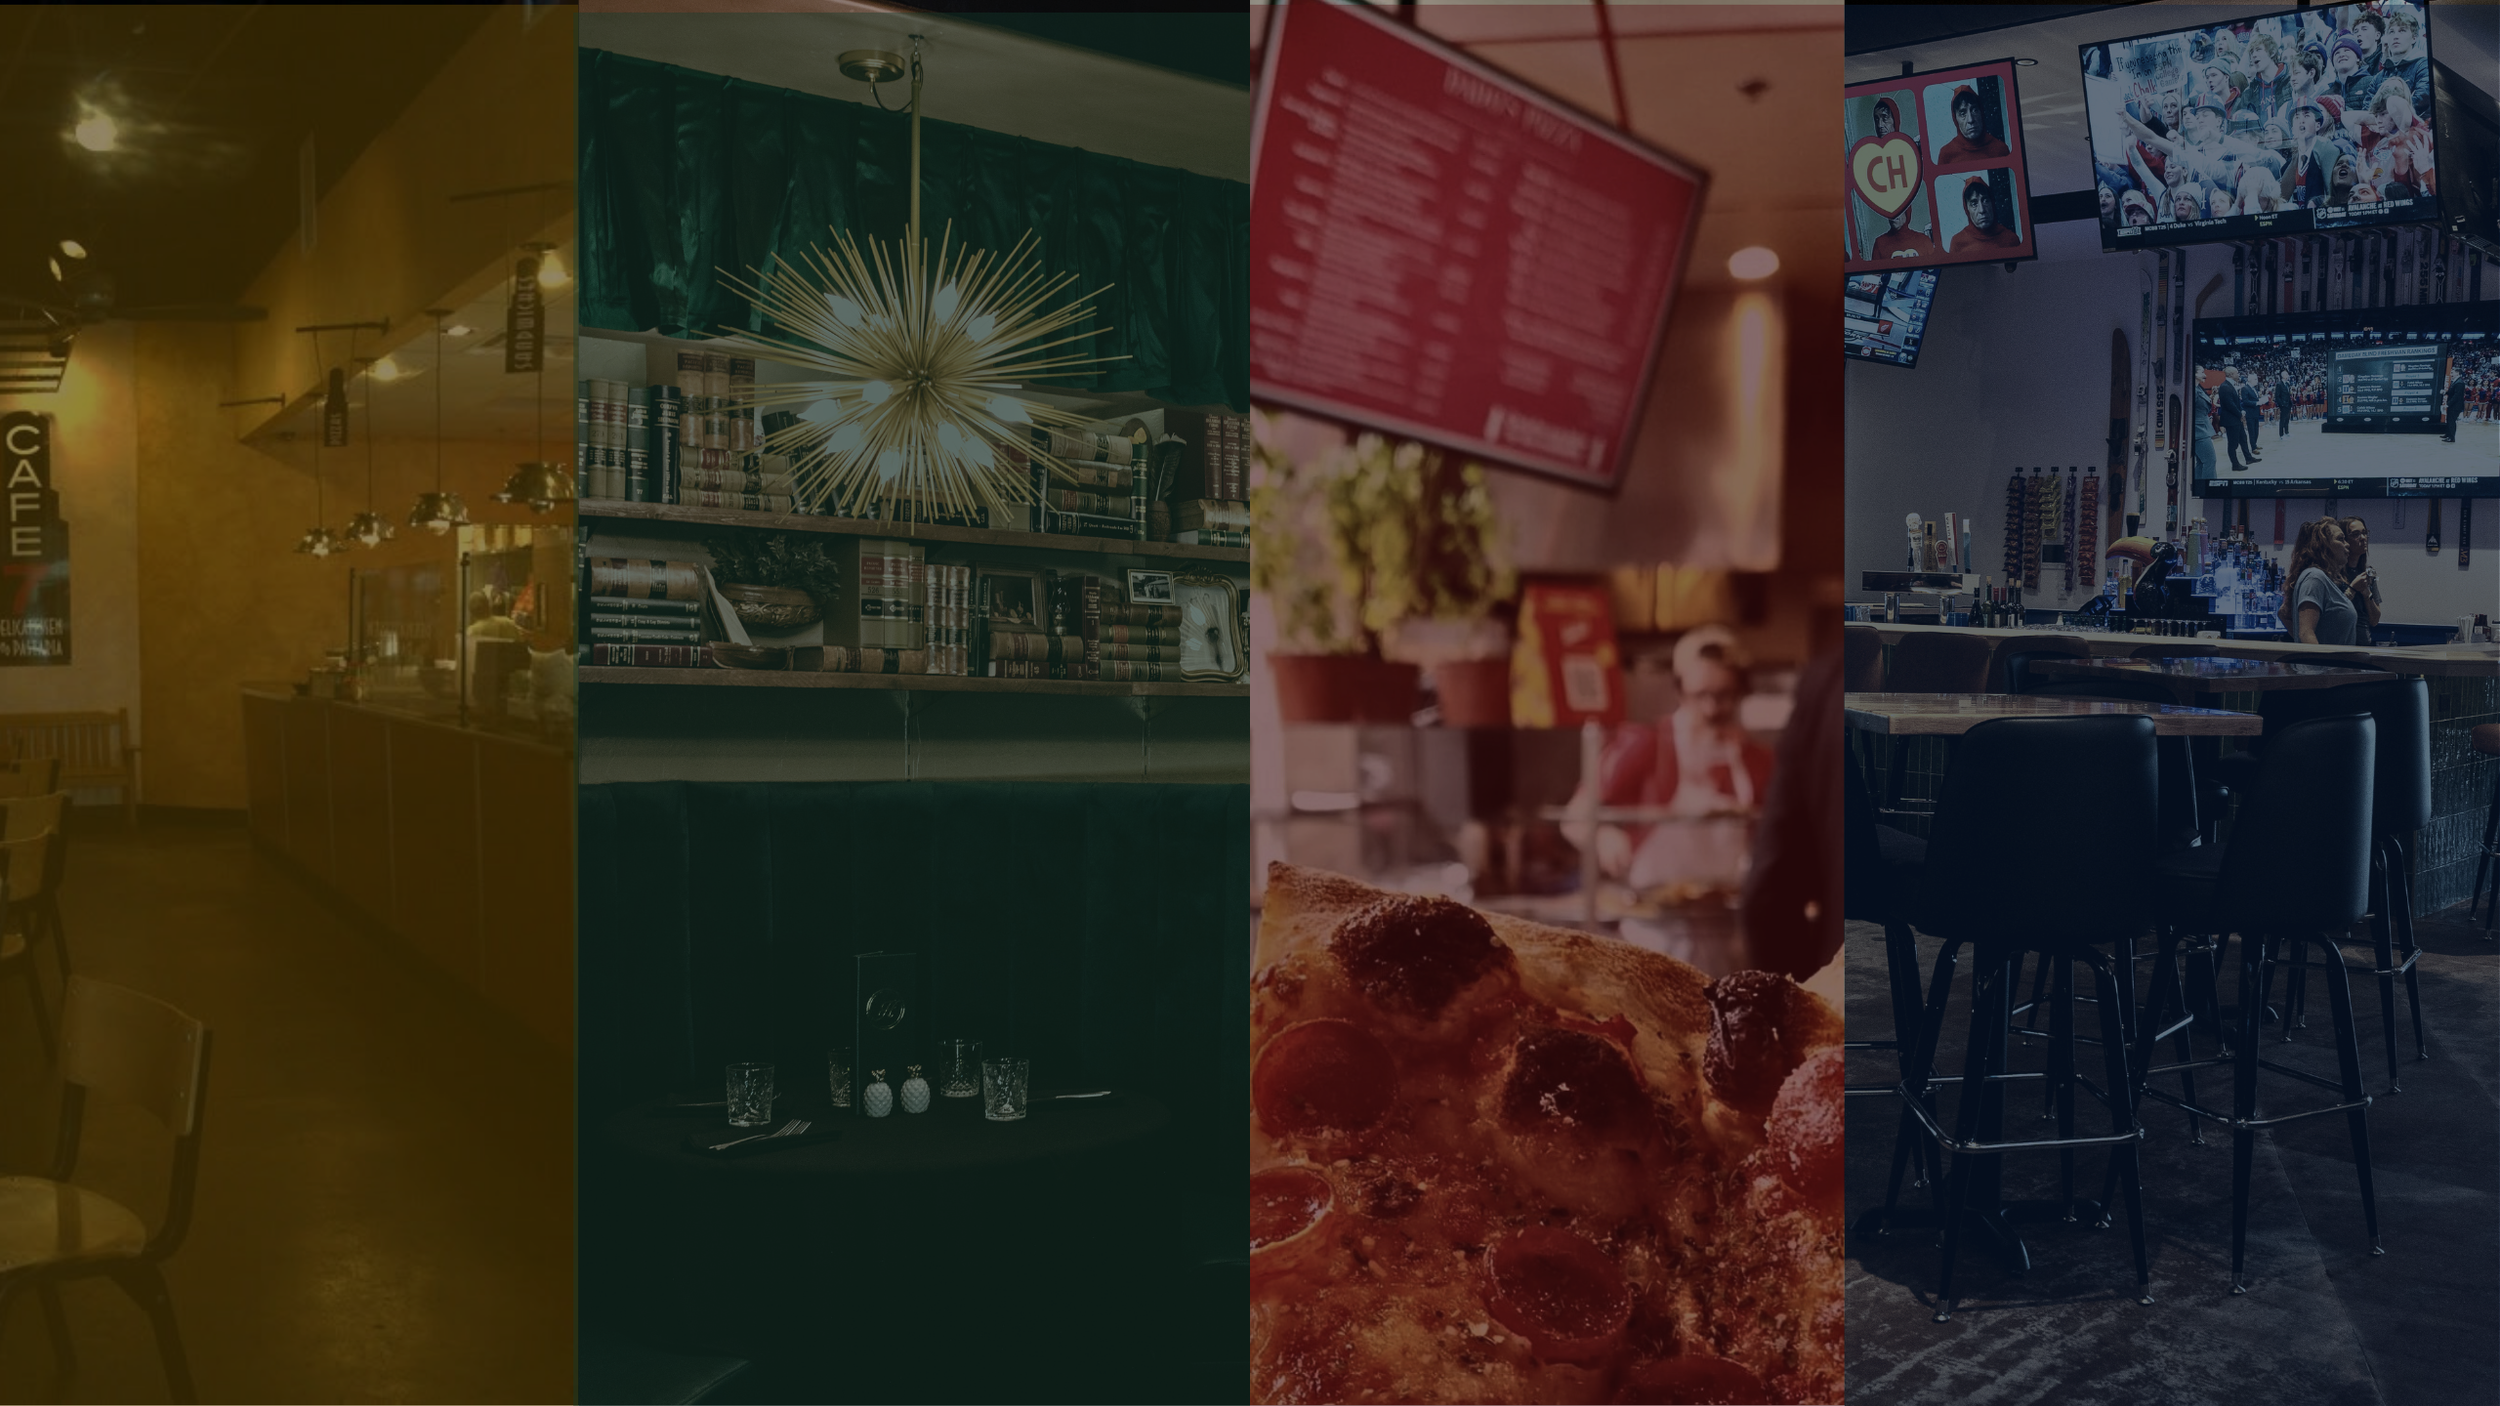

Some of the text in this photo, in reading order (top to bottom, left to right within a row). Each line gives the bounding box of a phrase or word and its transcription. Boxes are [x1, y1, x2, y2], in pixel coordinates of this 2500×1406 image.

[2133, 79, 2157, 98] Chalk
[1867, 155, 1908, 193] CH
[2348, 202, 2377, 211] AVALANCHE
[2383, 200, 2395, 208] RED
[2395, 199, 2413, 207] WINGS
[2420, 261, 2429, 287] 255
[515, 276, 535, 369] SANDWICHES
[2156, 386, 2164, 408] 255
[6, 425, 43, 556] CAFE
[2, 562, 50, 615] 7
[867, 586, 880, 594] 526
[0, 617, 63, 637] ELICATESSEN
